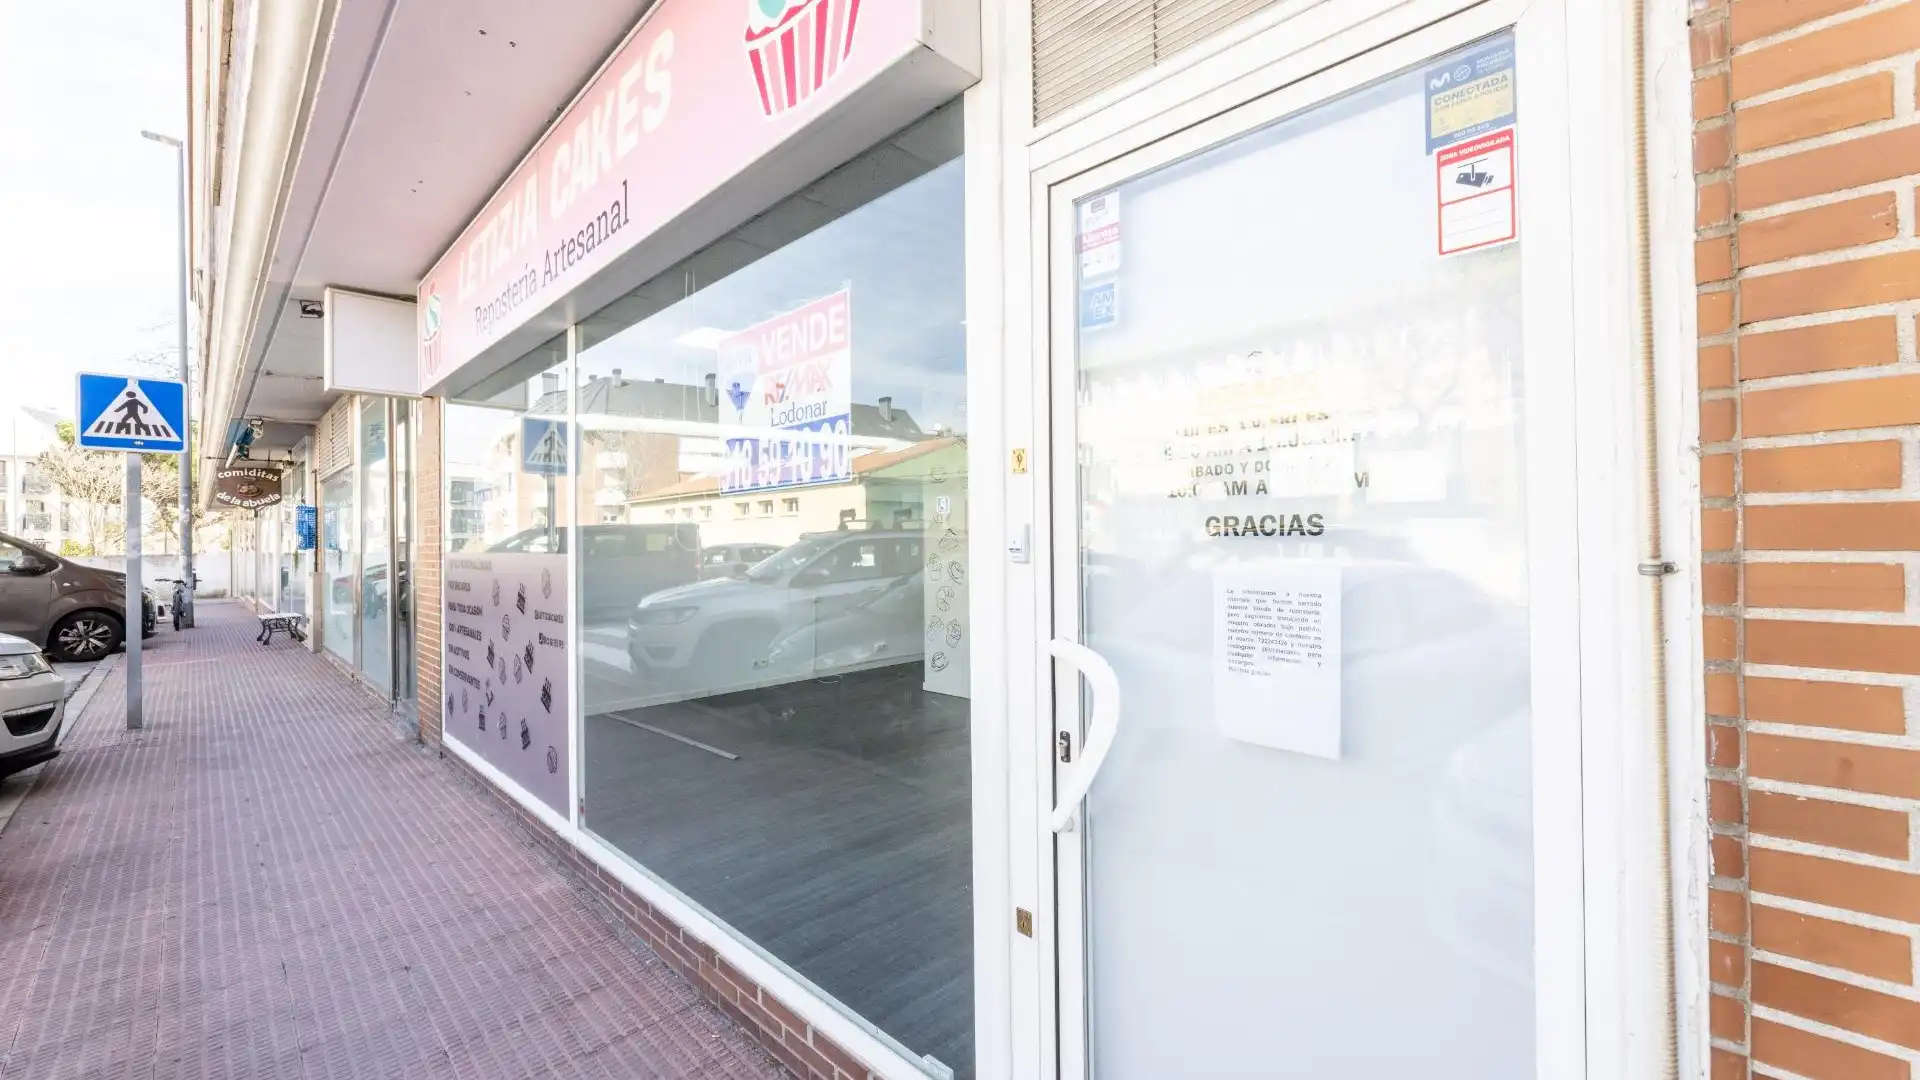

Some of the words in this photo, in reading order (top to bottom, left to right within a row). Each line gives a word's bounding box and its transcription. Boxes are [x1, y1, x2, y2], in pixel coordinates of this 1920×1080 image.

[1434, 74, 1508, 105] CONECTADA
[1440, 151, 1458, 162] ZONA
[1459, 136, 1511, 156] VIDEOVIGILADA
[457, 170, 540, 304] LETIZIA
[550, 28, 675, 219] CAKES
[475, 262, 538, 336] Repostería
[541, 179, 630, 287] Artesanal
[761, 303, 846, 366] VENDE
[771, 400, 828, 427] Lodonar
[218, 468, 280, 481] comiditas
[1191, 463, 1234, 478] BADO
[1240, 461, 1249, 474] Y
[242, 493, 280, 507] abuela
[1255, 479, 1268, 495] A
[1205, 513, 1325, 537] GRACIAS
